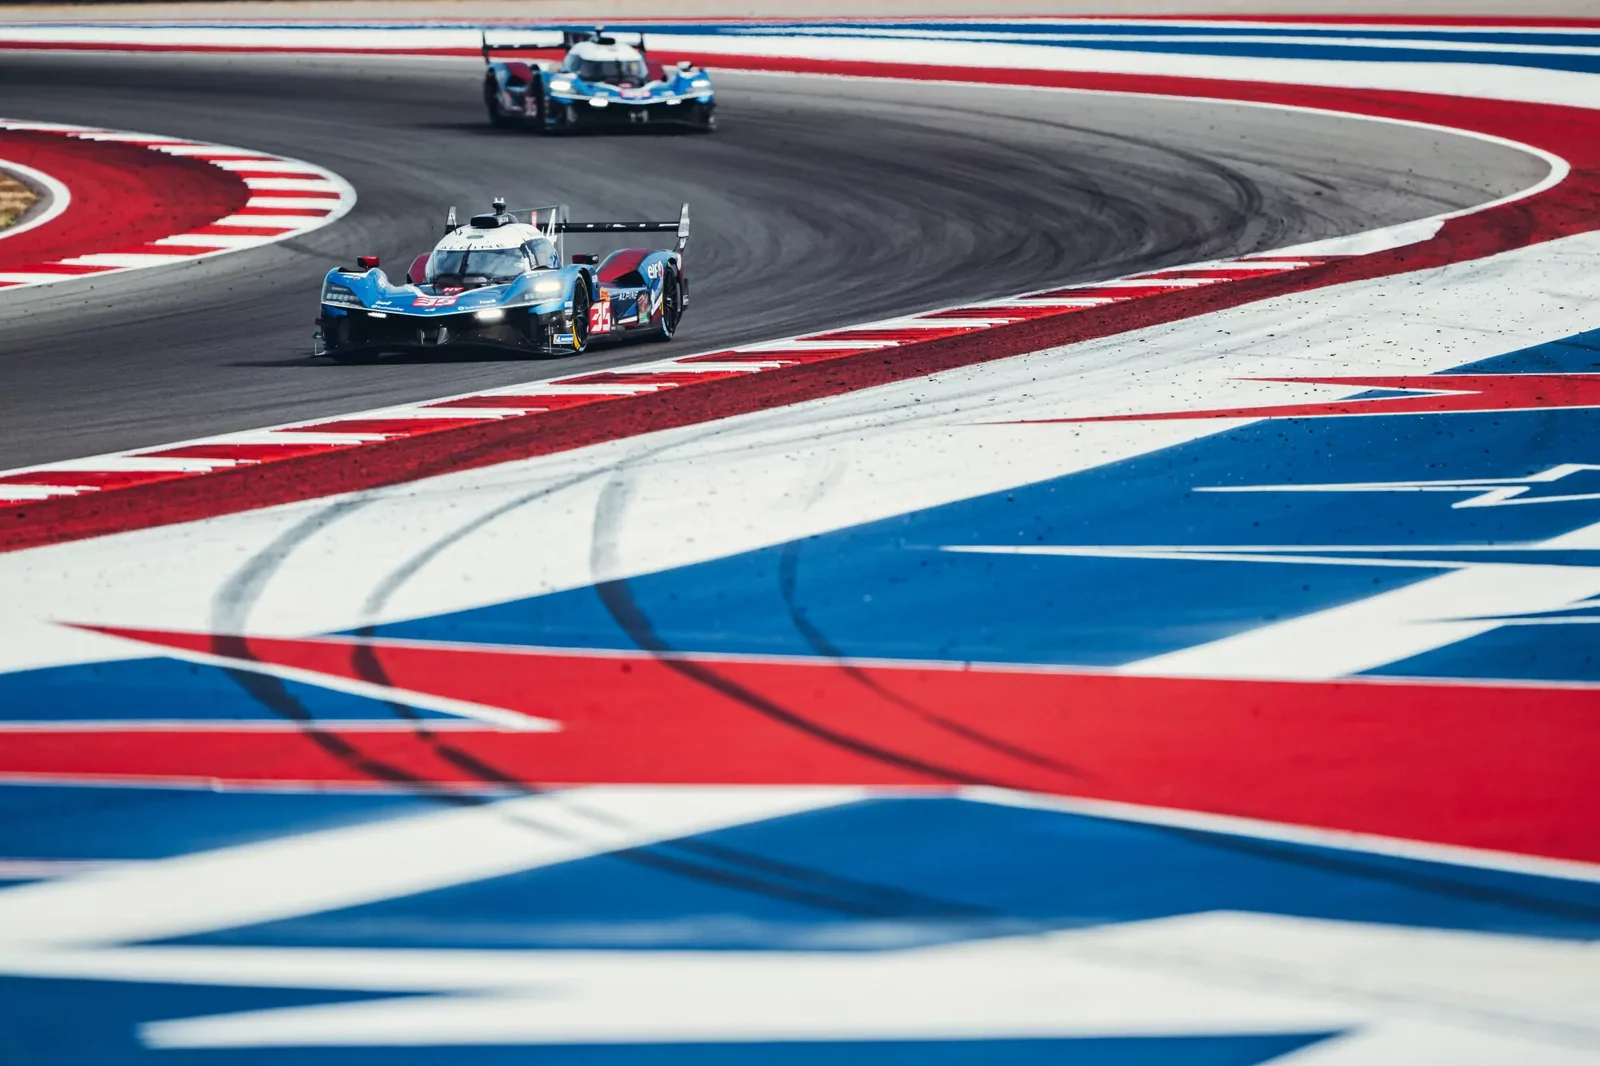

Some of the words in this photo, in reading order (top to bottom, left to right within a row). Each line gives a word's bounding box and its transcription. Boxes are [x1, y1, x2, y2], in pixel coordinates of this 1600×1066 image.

[618, 290, 639, 301] ALPINE
[414, 297, 458, 307] 35
[590, 301, 611, 332] 35
